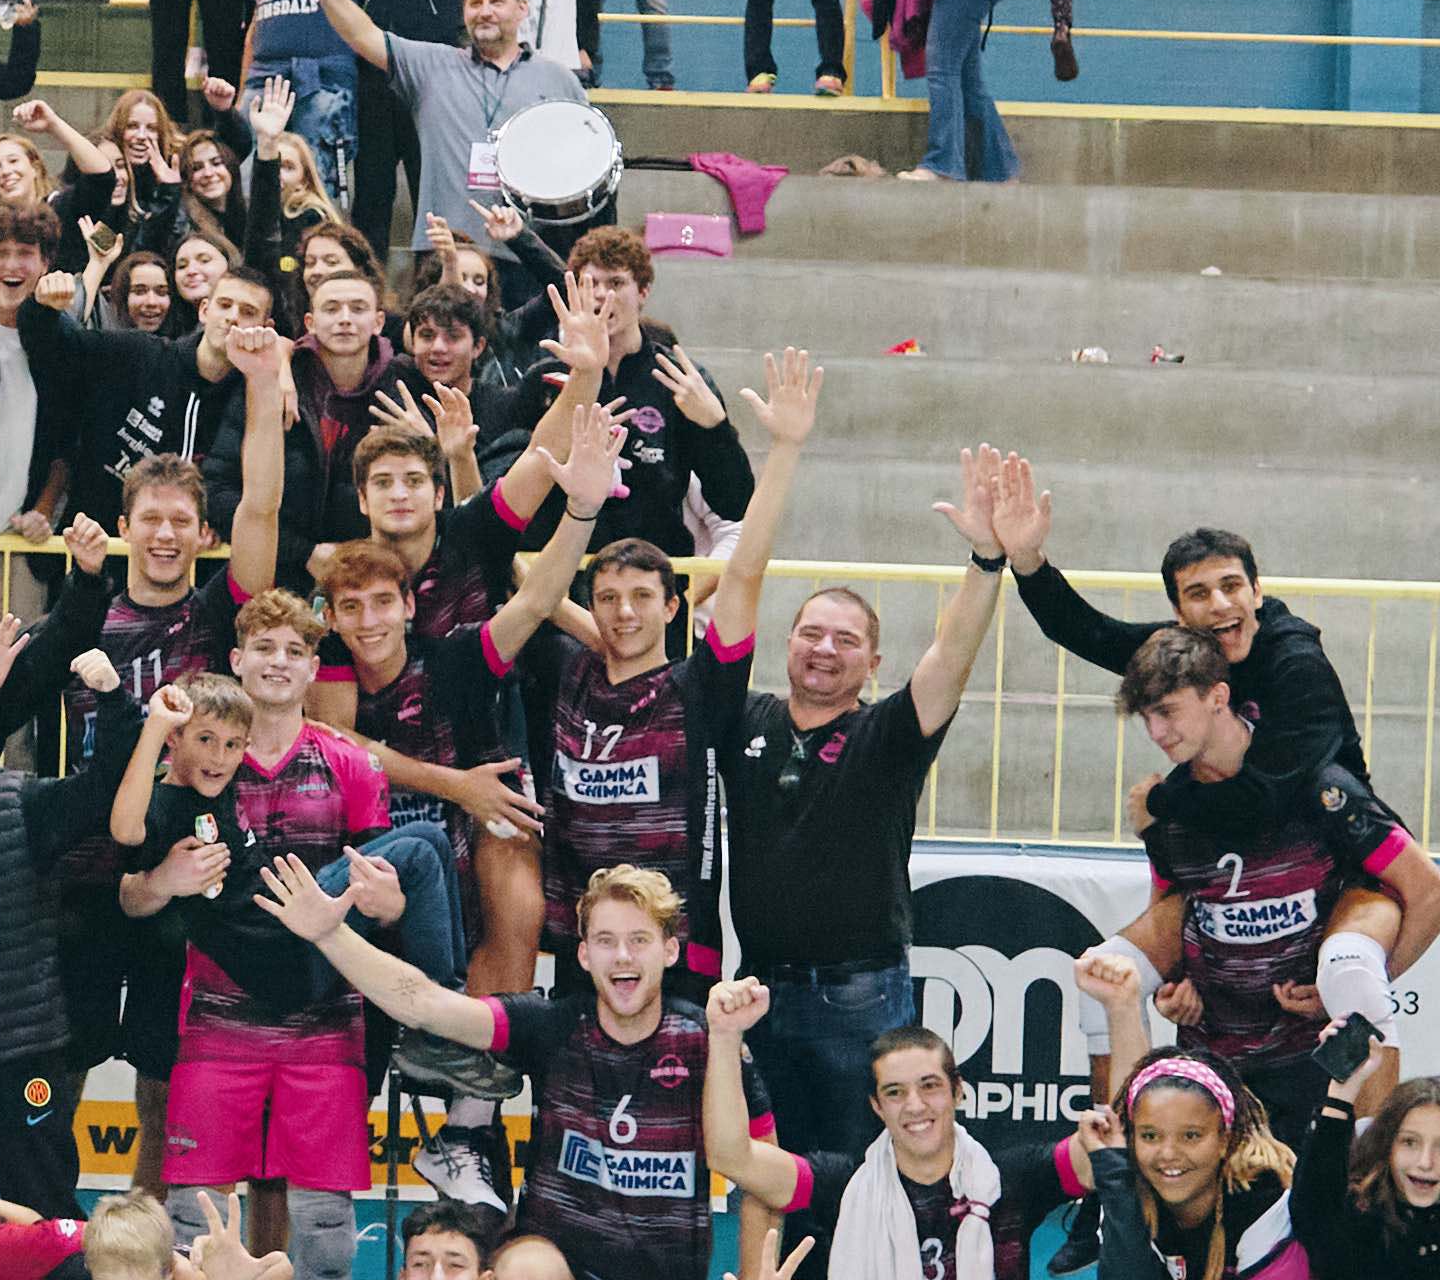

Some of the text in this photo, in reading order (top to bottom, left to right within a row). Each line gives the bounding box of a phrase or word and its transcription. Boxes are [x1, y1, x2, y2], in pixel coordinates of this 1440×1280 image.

[578, 764, 647, 784] GAMMA
[1213, 852, 1249, 898] 2
[1220, 901, 1300, 922] GAMMA
[1222, 912, 1306, 937] CHIMICA
[607, 1094, 637, 1144] 6
[603, 1154, 686, 1174] GAMMA
